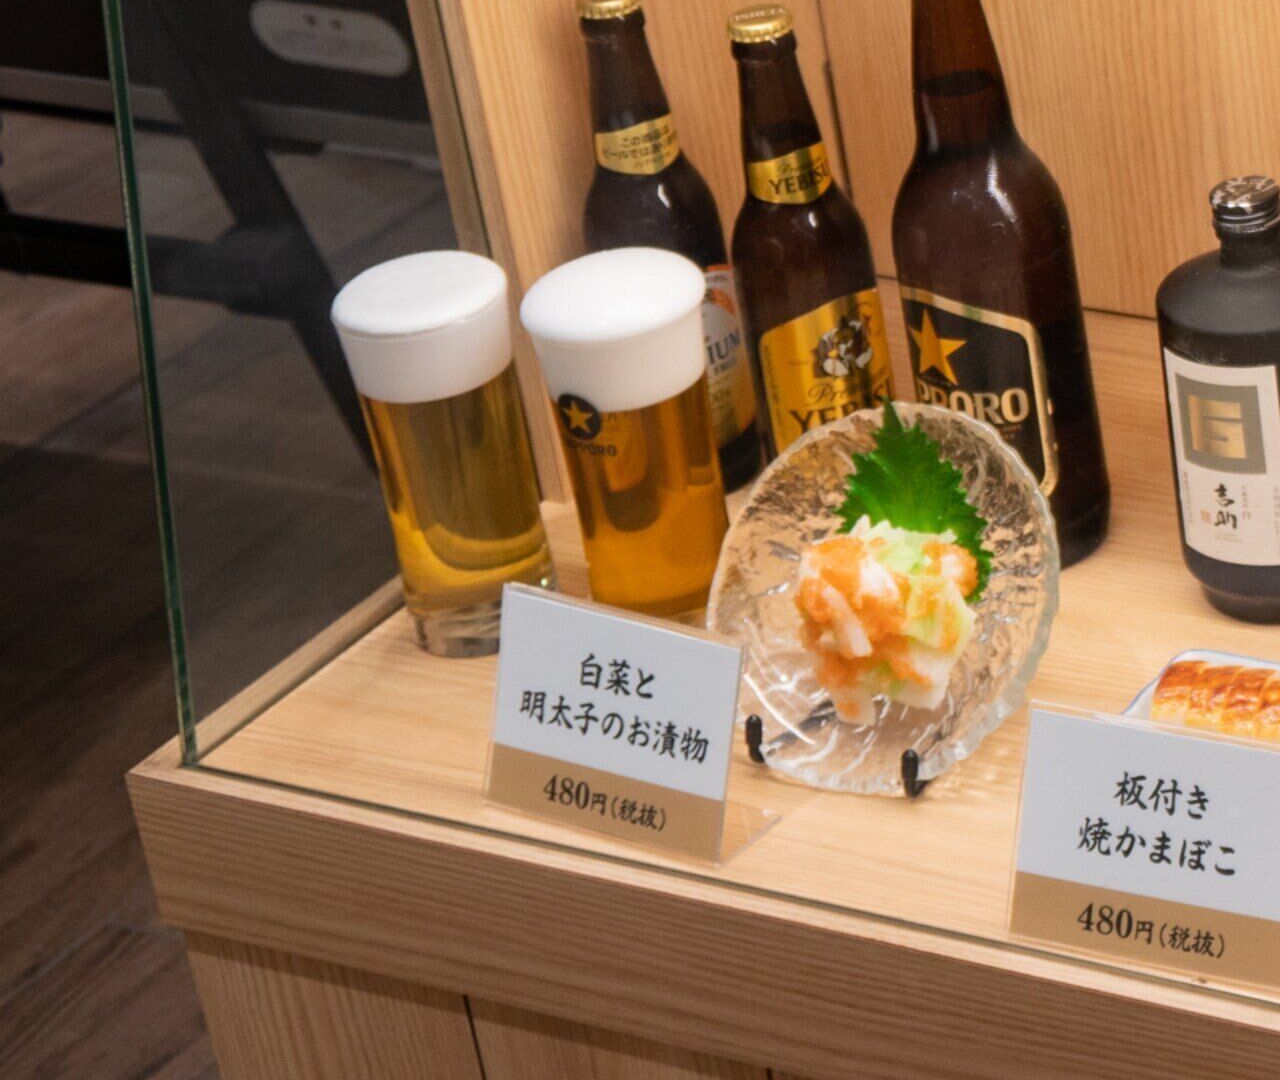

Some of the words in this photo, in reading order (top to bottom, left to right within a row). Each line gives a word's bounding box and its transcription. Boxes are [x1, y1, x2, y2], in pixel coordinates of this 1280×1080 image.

[917, 378, 1029, 424] PPORO
[579, 653, 655, 699] 白菜と
[520, 690, 709, 764] 明太子のお漬物
[543, 774, 667, 832] 480円（税抜）
[1113, 771, 1210, 820] 板付き
[1077, 816, 1237, 877] 焼かまぼこ
[1077, 902, 1226, 959] 480円（税抜）
